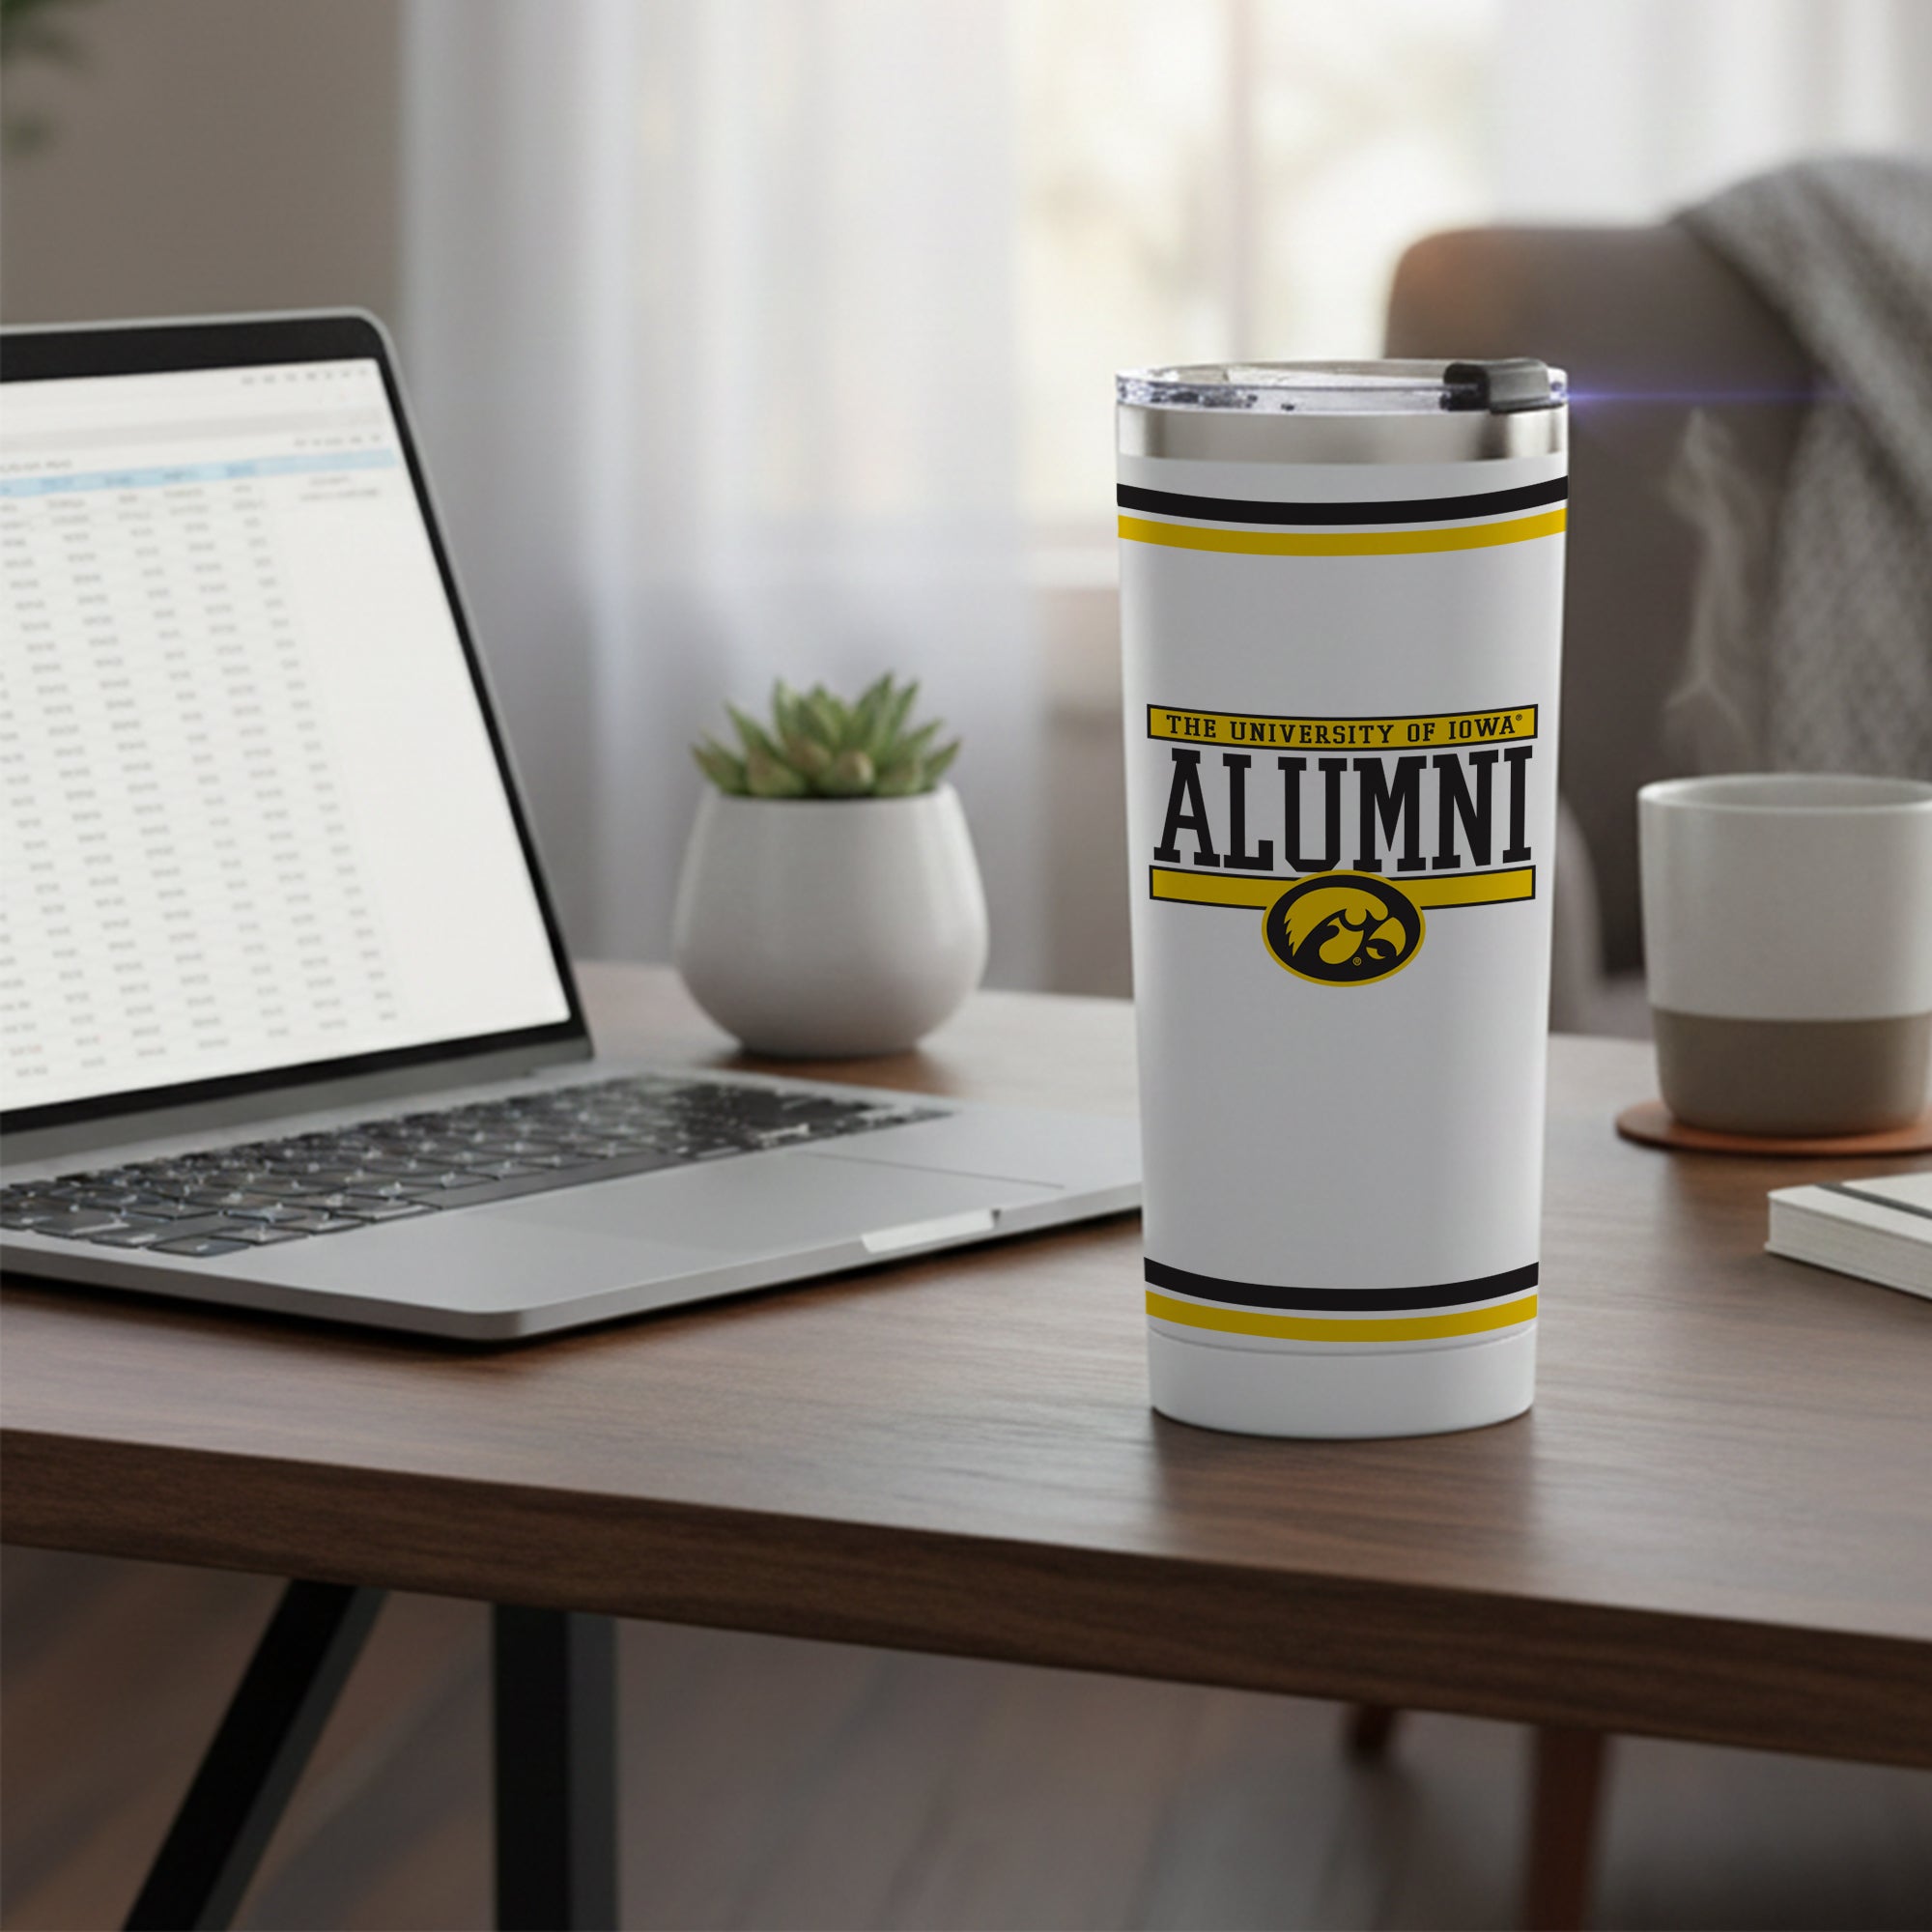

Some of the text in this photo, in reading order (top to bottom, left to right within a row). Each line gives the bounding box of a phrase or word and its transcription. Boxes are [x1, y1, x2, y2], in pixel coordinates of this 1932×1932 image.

[1166, 714, 1216, 738] THE
[1230, 721, 1394, 744] UNIVERSITY
[1406, 723, 1435, 743] OF
[1153, 745, 1533, 872] ALUMNI
